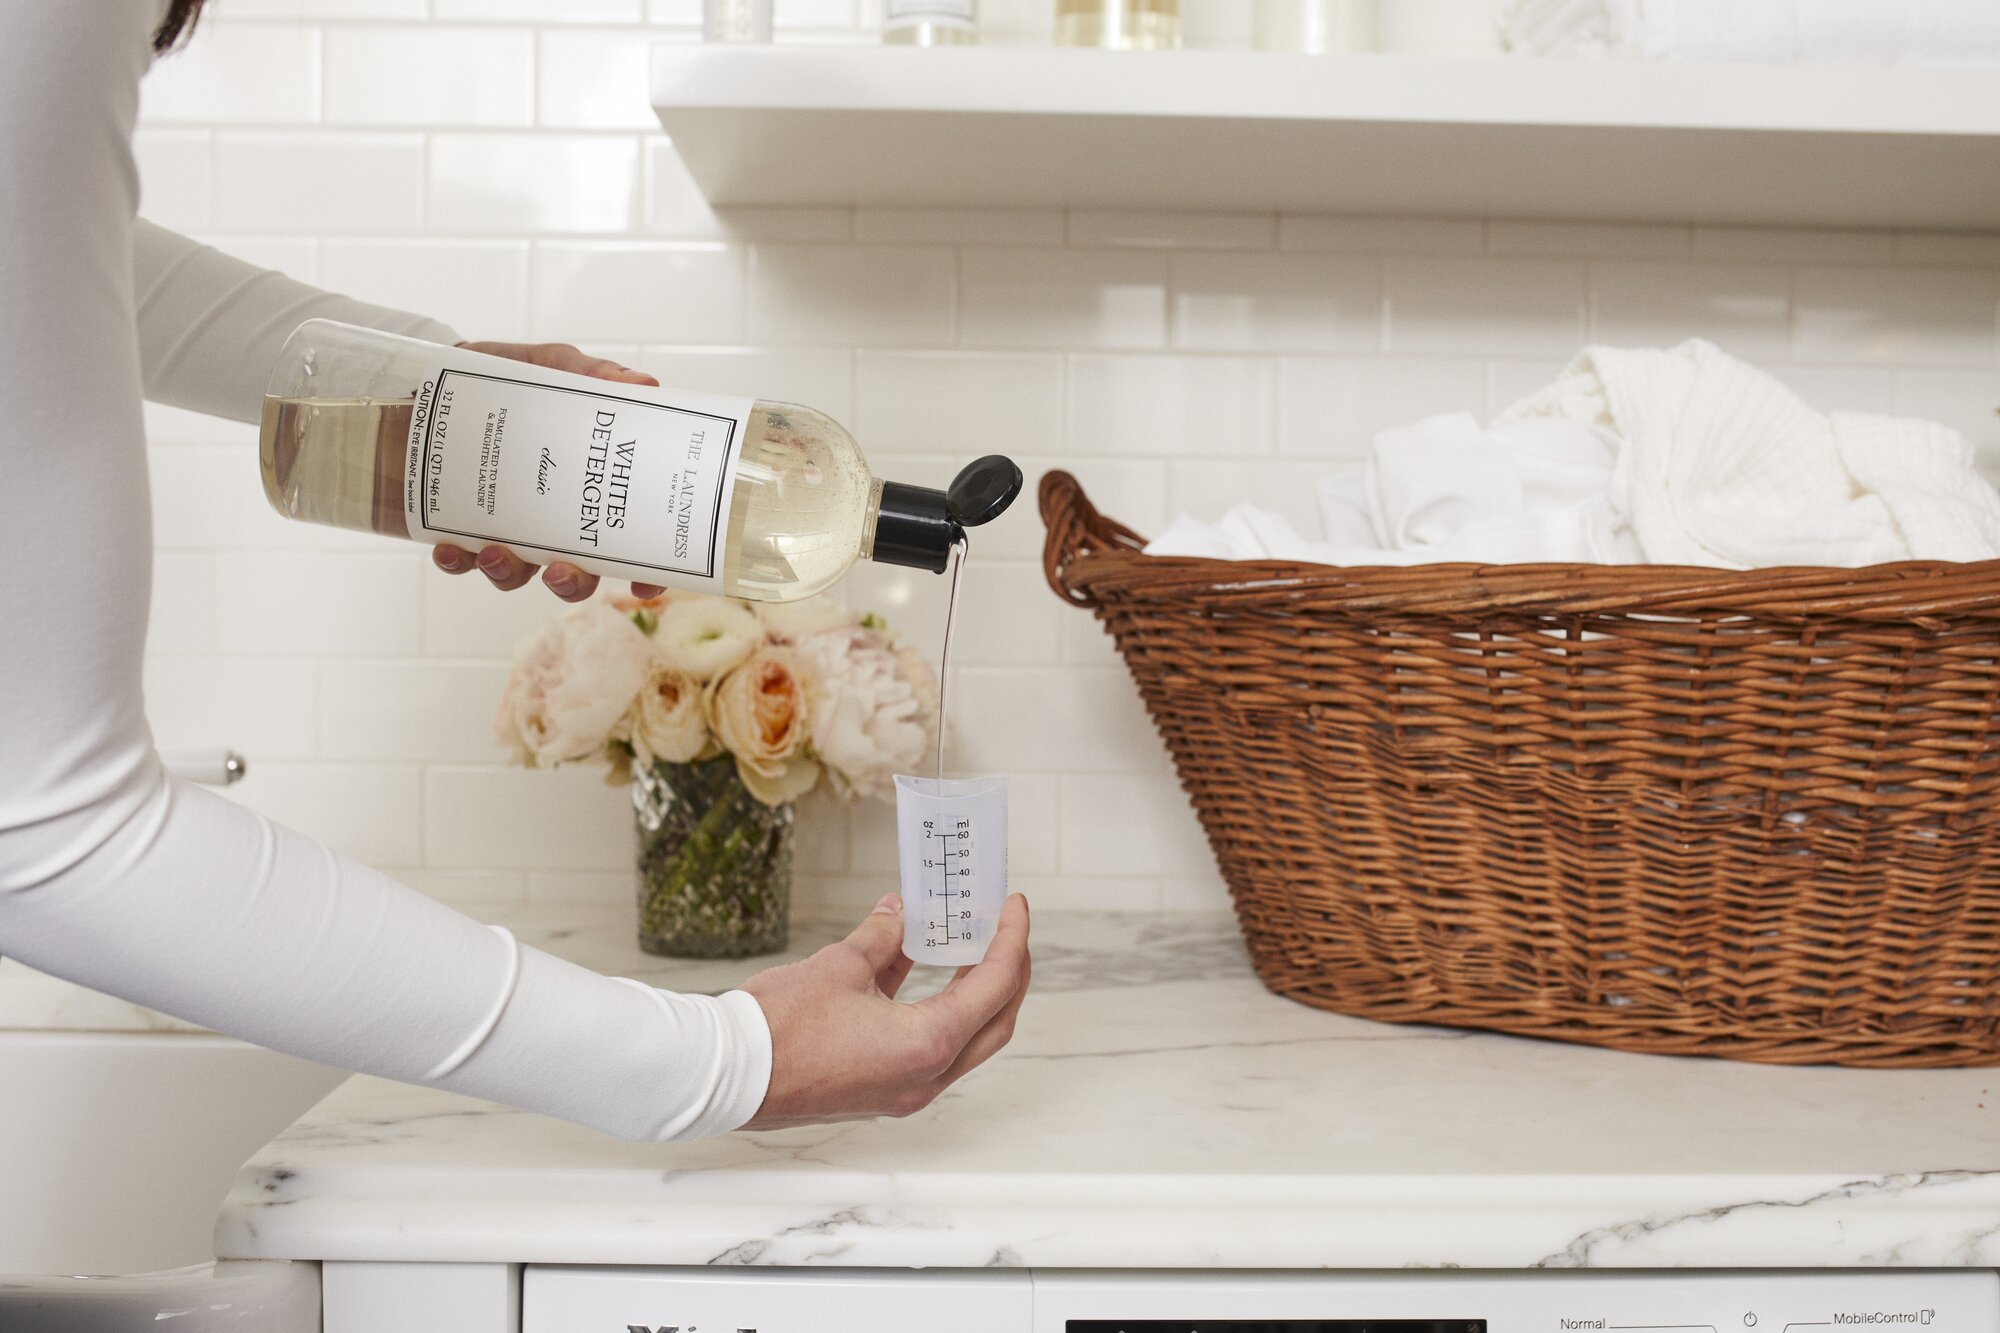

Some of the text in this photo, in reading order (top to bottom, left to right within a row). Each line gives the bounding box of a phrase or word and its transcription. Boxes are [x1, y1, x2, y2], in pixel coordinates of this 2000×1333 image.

[414, 380, 434, 431] CAUTION:
[411, 432, 421, 445] EYE
[429, 389, 454, 514] 32 FL OZ (1 QT) 946 mL
[408, 446, 418, 478] IRRITANT.
[477, 412, 496, 508] & BRIGHTEN LAUNDRY
[487, 407, 508, 516] FORMULATED TO WHITEN
[536, 446, 557, 497] classic
[579, 409, 616, 547] DETERGENT
[605, 439, 637, 530] WHITES
[674, 431, 705, 559] THE LAUNDRESS
[667, 494, 675, 514] YORK
[923, 819, 970, 829] oz ml
[926, 830, 969, 840] 2 60
[958, 849, 970, 858] 50
[923, 859, 933, 869] 1.5
[959, 868, 970, 877] 40
[928, 889, 933, 898] 1
[959, 889, 971, 898] 30
[960, 910, 971, 919] 20
[927, 921, 935, 930] .5
[925, 938, 936, 947] .25
[961, 932, 972, 941] 10
[1560, 1317, 1606, 1331] Normal
[1833, 1310, 1919, 1325] MobileControl
